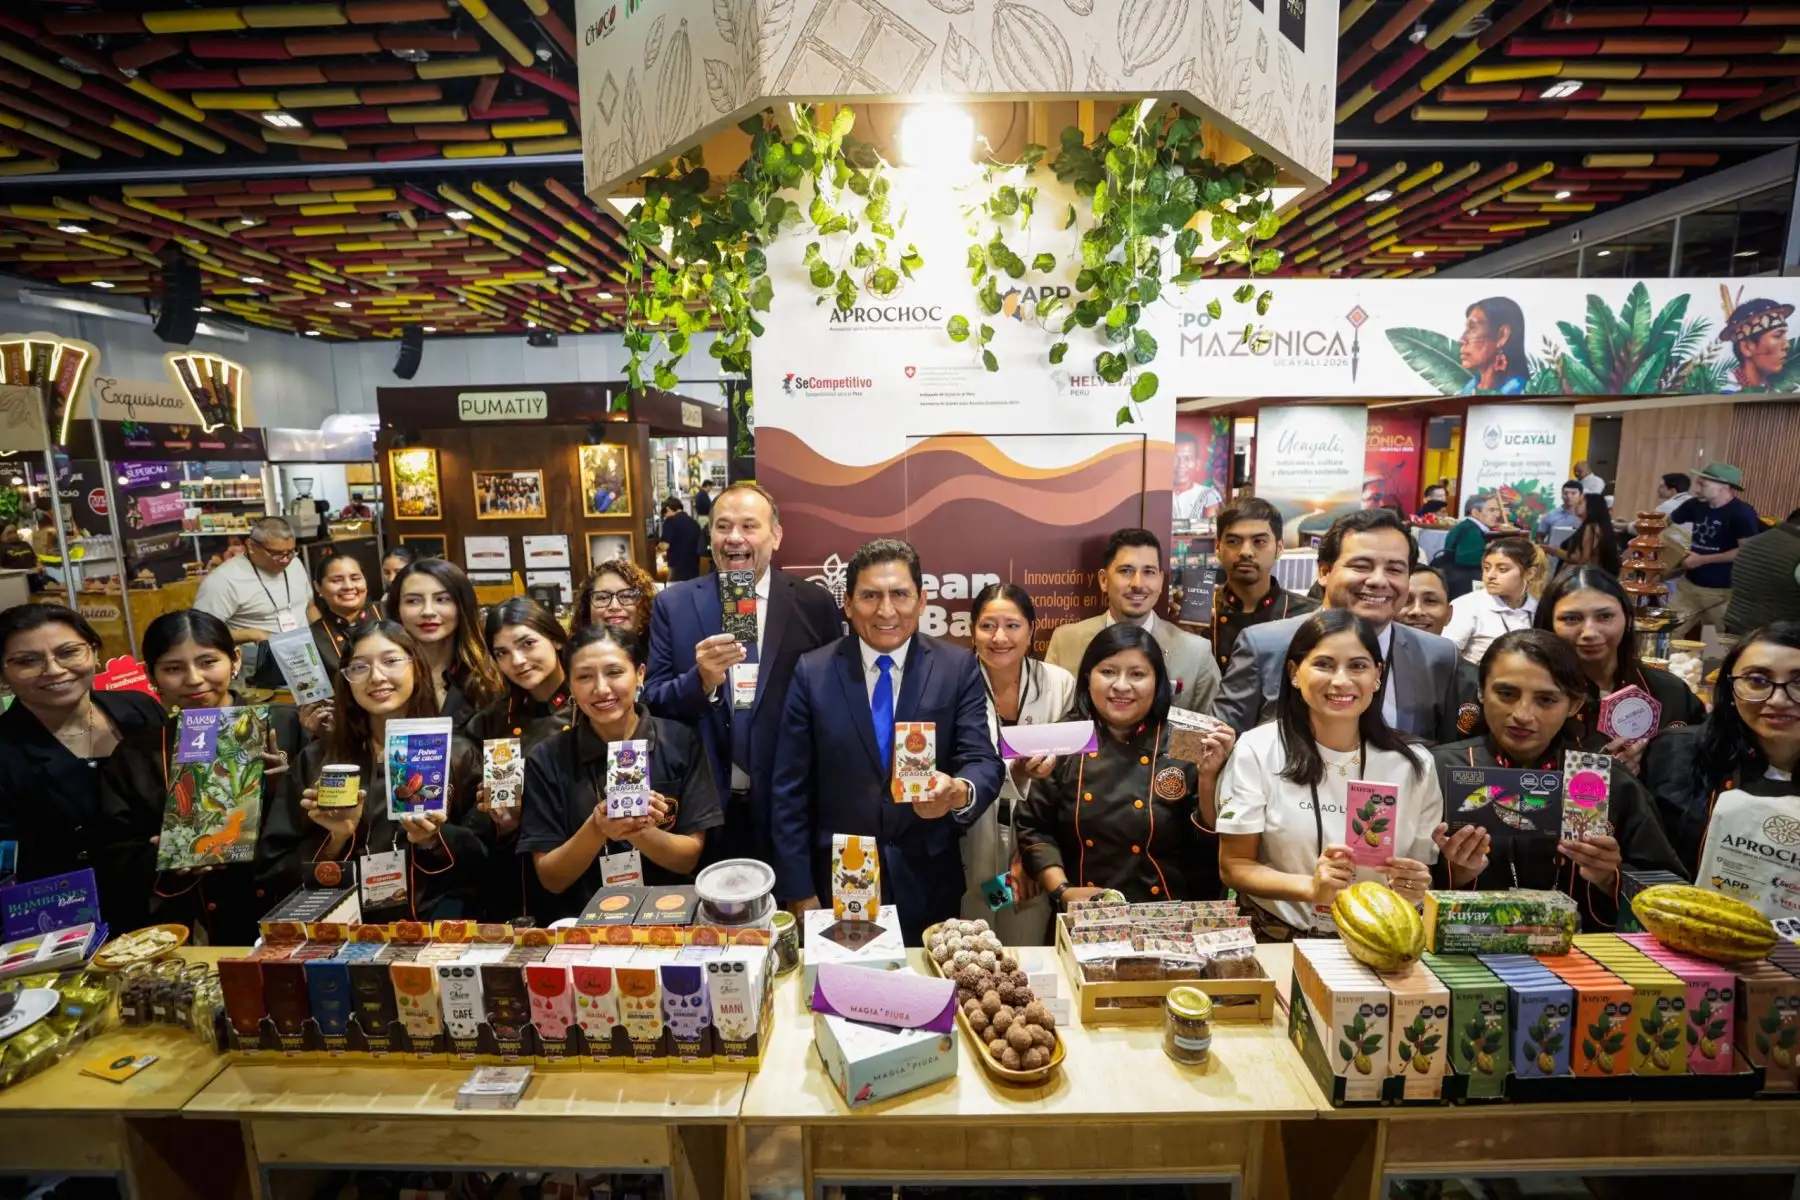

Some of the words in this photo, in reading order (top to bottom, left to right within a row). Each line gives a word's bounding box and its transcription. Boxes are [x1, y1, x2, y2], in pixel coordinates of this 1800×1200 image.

[829, 306, 943, 323] APROCHOC
[1179, 313, 1211, 328] PO
[1180, 324, 1348, 357] MAZÓNICA
[1323, 359, 1349, 367] 2026
[795, 376, 873, 391] SeCompetitivo
[1504, 434, 1556, 445] UCAYALI
[923, 572, 1001, 599] ean
[1024, 569, 1080, 585] Innovación
[1083, 572, 1094, 587] y
[1031, 591, 1080, 610] ecnología
[1083, 595, 1097, 607] en
[191, 732, 206, 749] 4
[1299, 801, 1337, 813] CAAO
[1447, 910, 1490, 922] kuyay
[1687, 980, 1711, 989] uyay
[452, 1008, 475, 1020] CAFÉ
[720, 1001, 744, 1014] MANÍ
[850, 1005, 879, 1015] MAGIA
[884, 1010, 910, 1021] PIURA
[873, 1067, 907, 1082] MAGIA
[911, 1056, 940, 1071] PIURA
